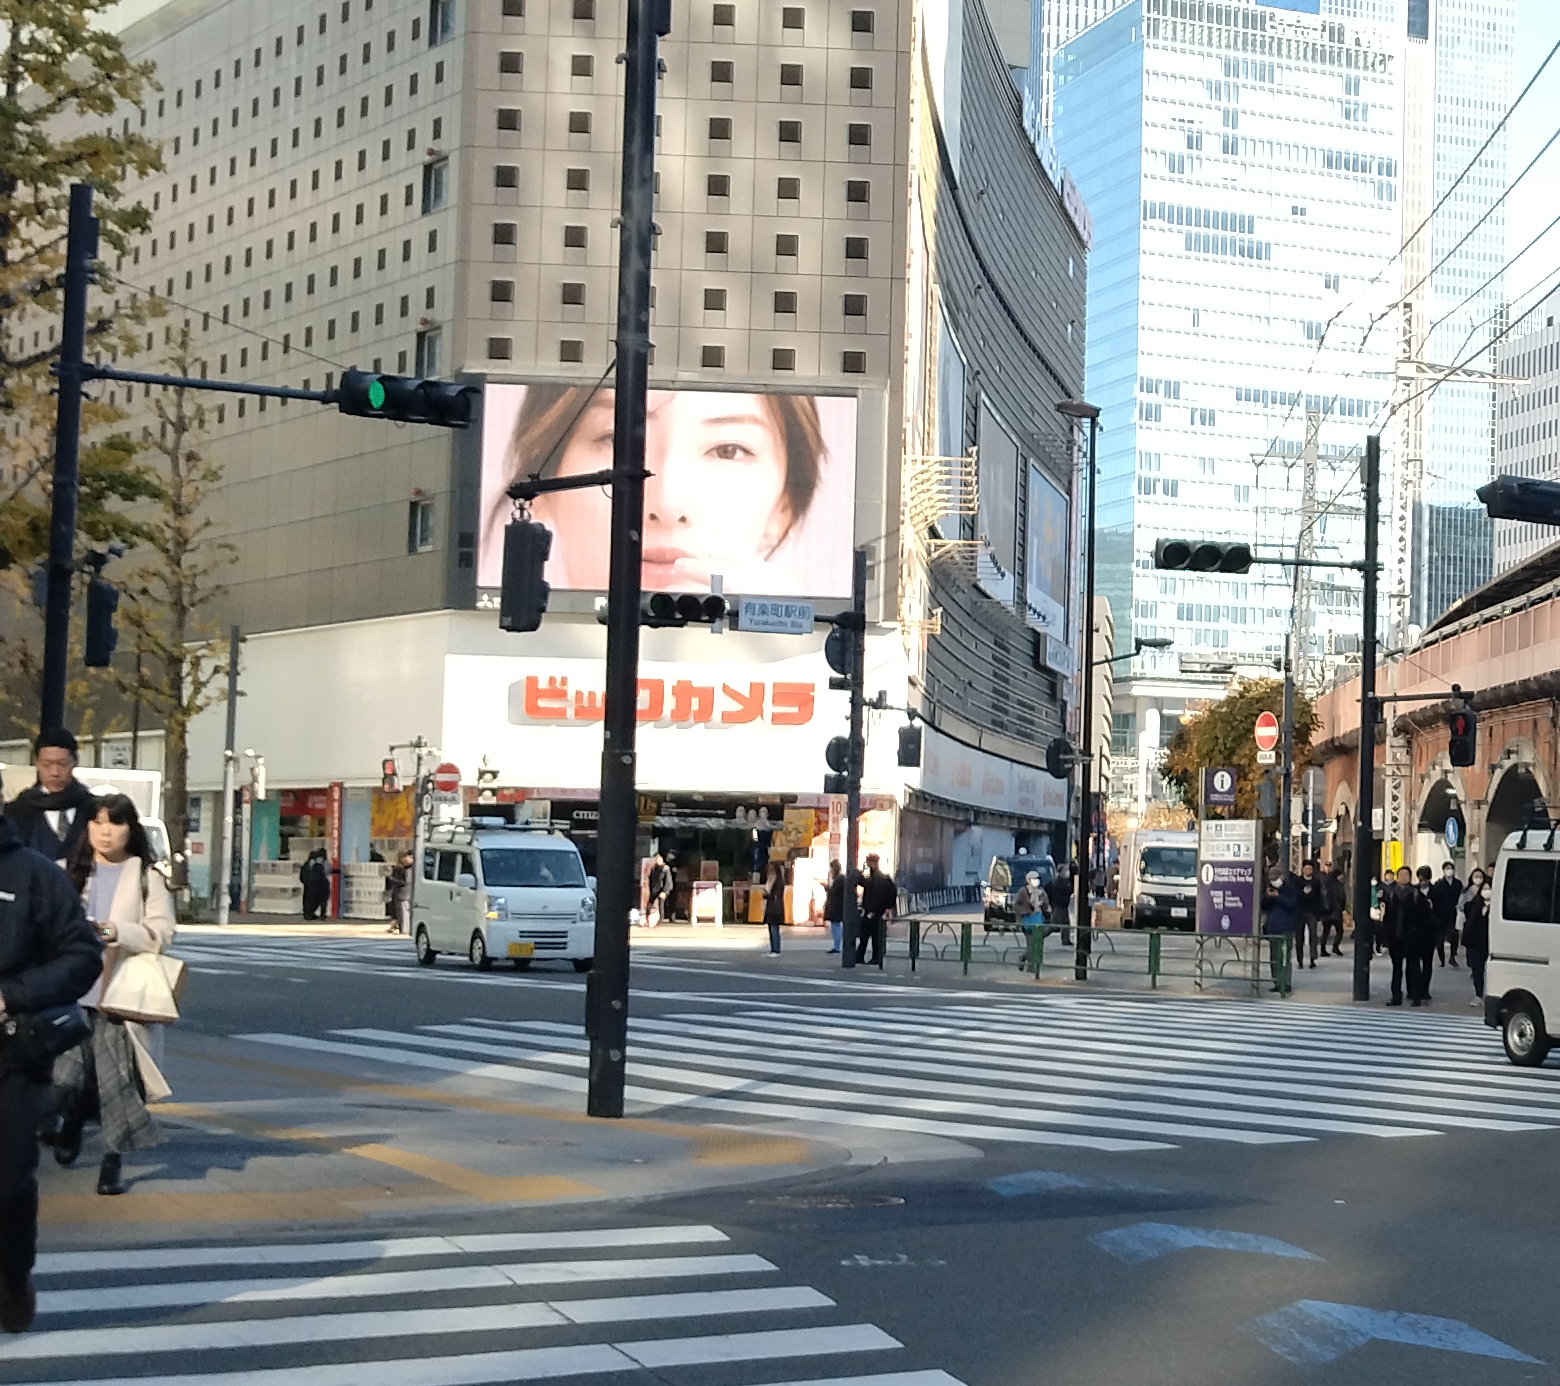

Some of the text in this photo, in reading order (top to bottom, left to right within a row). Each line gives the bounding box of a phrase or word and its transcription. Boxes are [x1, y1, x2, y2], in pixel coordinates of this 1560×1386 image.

[744, 601, 811, 620] 有楽町駅前
[523, 674, 816, 726] ビックカメラ
